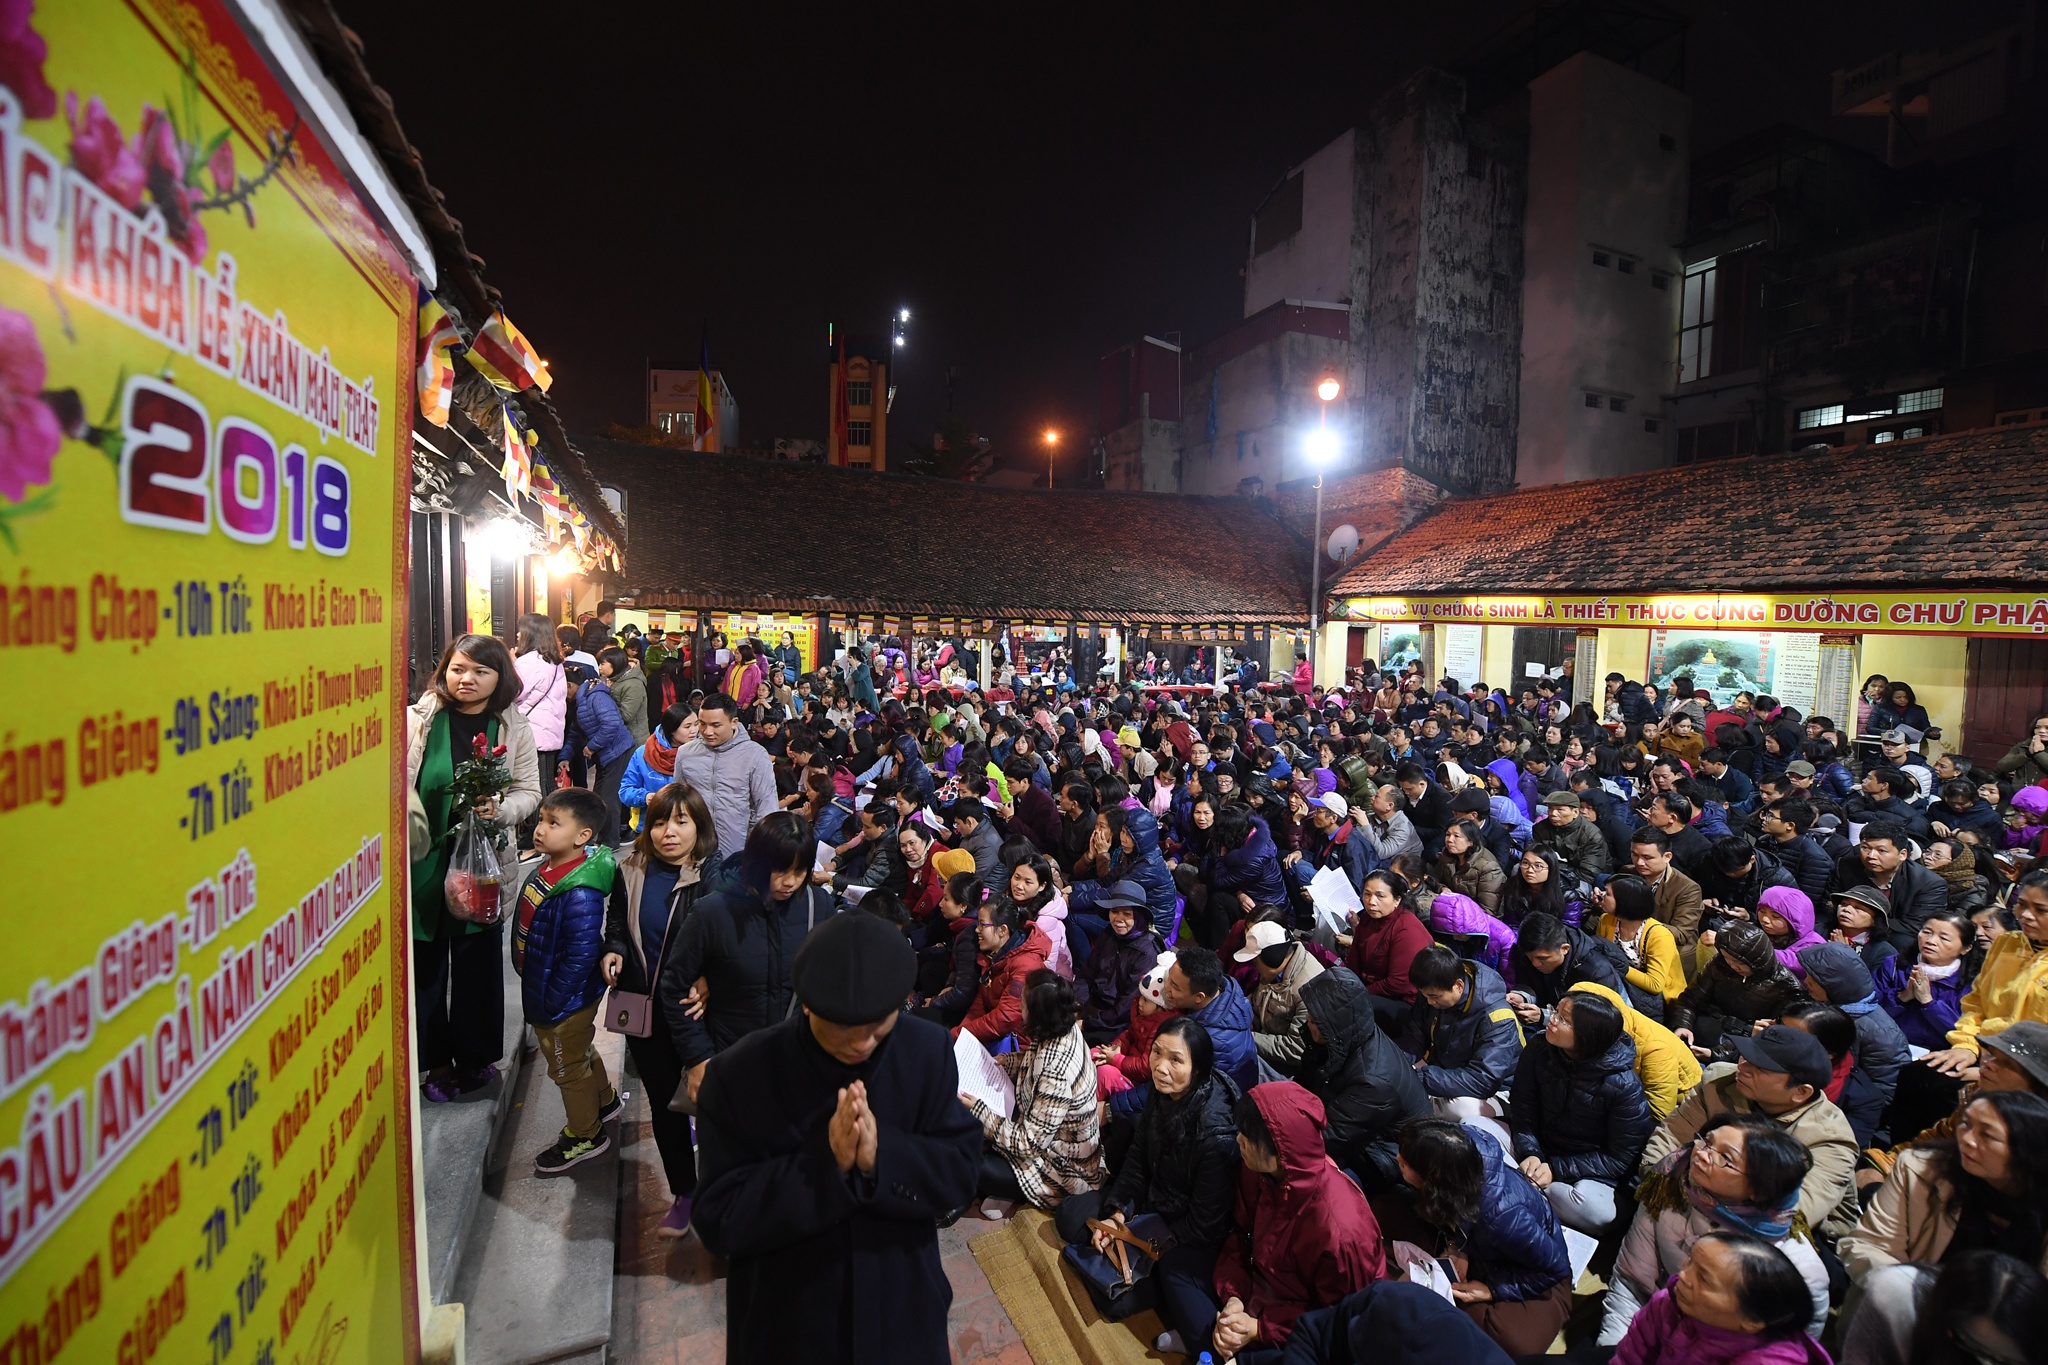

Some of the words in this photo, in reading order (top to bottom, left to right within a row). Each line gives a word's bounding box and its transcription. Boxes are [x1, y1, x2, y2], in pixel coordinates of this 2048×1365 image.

[71, 183, 187, 348] KHÓA
[197, 259, 233, 371] LỄ
[240, 307, 300, 411] XUÂN
[303, 351, 342, 440] MẬU
[343, 379, 379, 453] TUẤT
[124, 377, 350, 553] 2018
[89, 572, 159, 655] Chạp
[163, 580, 212, 638] -10h
[218, 573, 252, 635] Tối:
[263, 582, 305, 631] Khóa
[309, 578, 326, 628] Lễ
[330, 585, 357, 627] Giao
[359, 587, 383, 625] Thừa
[1373, 603, 1407, 619] PHỤC
[1411, 603, 1429, 620] VỤ
[1432, 600, 1485, 617] CHÚNG
[1488, 602, 1529, 619] SINH
[1533, 600, 1556, 619] LÀ
[1560, 597, 1621, 620] THIẾT
[1773, 598, 1881, 624] DƯỜNG
[1888, 598, 1968, 625] CHƯ
[78, 708, 160, 788] Giêng
[164, 695, 202, 756] -9h
[207, 686, 260, 745] Sáng:
[263, 676, 298, 730] Khóa
[300, 665, 315, 718] Lễ
[316, 670, 352, 716] Thượng
[353, 658, 383, 703] Nguyên
[179, 781, 215, 842] -7h
[219, 757, 254, 826] Tối:
[263, 745, 304, 804] Khóa
[306, 728, 323, 782] Lễ
[325, 730, 348, 772] Sao
[350, 722, 363, 760] La
[102, 918, 175, 1013] Giêng
[181, 884, 217, 945] -7h
[220, 852, 255, 925] Tối:
[0, 1093, 81, 1260] CẦU
[98, 1043, 146, 1159] AN
[156, 978, 194, 1095] CẢ
[201, 946, 256, 1053] NĂM
[262, 911, 297, 992] CHO
[301, 880, 330, 953] MỌI
[333, 861, 354, 921] GIA
[355, 833, 382, 899] ĐÌNH
[0, 1252, 102, 1365] háng
[109, 1157, 181, 1280] Giêng
[189, 1104, 223, 1170] -7h
[227, 1056, 260, 1132] Tối:
[268, 1013, 302, 1083] Khóa
[304, 979, 319, 1038] Lễ
[320, 968, 340, 1017] Sao
[341, 935, 361, 990] Thái
[362, 913, 382, 965] Bạch
[194, 1203, 229, 1273] -7h
[230, 1150, 264, 1229] Tối:
[271, 1087, 311, 1171] Khóa
[313, 1044, 330, 1108] Lễ
[331, 1025, 353, 1078] Sao
[355, 985, 370, 1043] Kế
[235, 1250, 268, 1331] Tối:
[274, 1167, 318, 1264] Khóa
[319, 1119, 337, 1185] Lễ
[338, 1086, 364, 1148] Tam
[365, 1049, 385, 1102] Quy
[278, 1254, 317, 1350] Khóa
[317, 1204, 334, 1272] Lễ
[357, 1113, 387, 1190] Khoán
